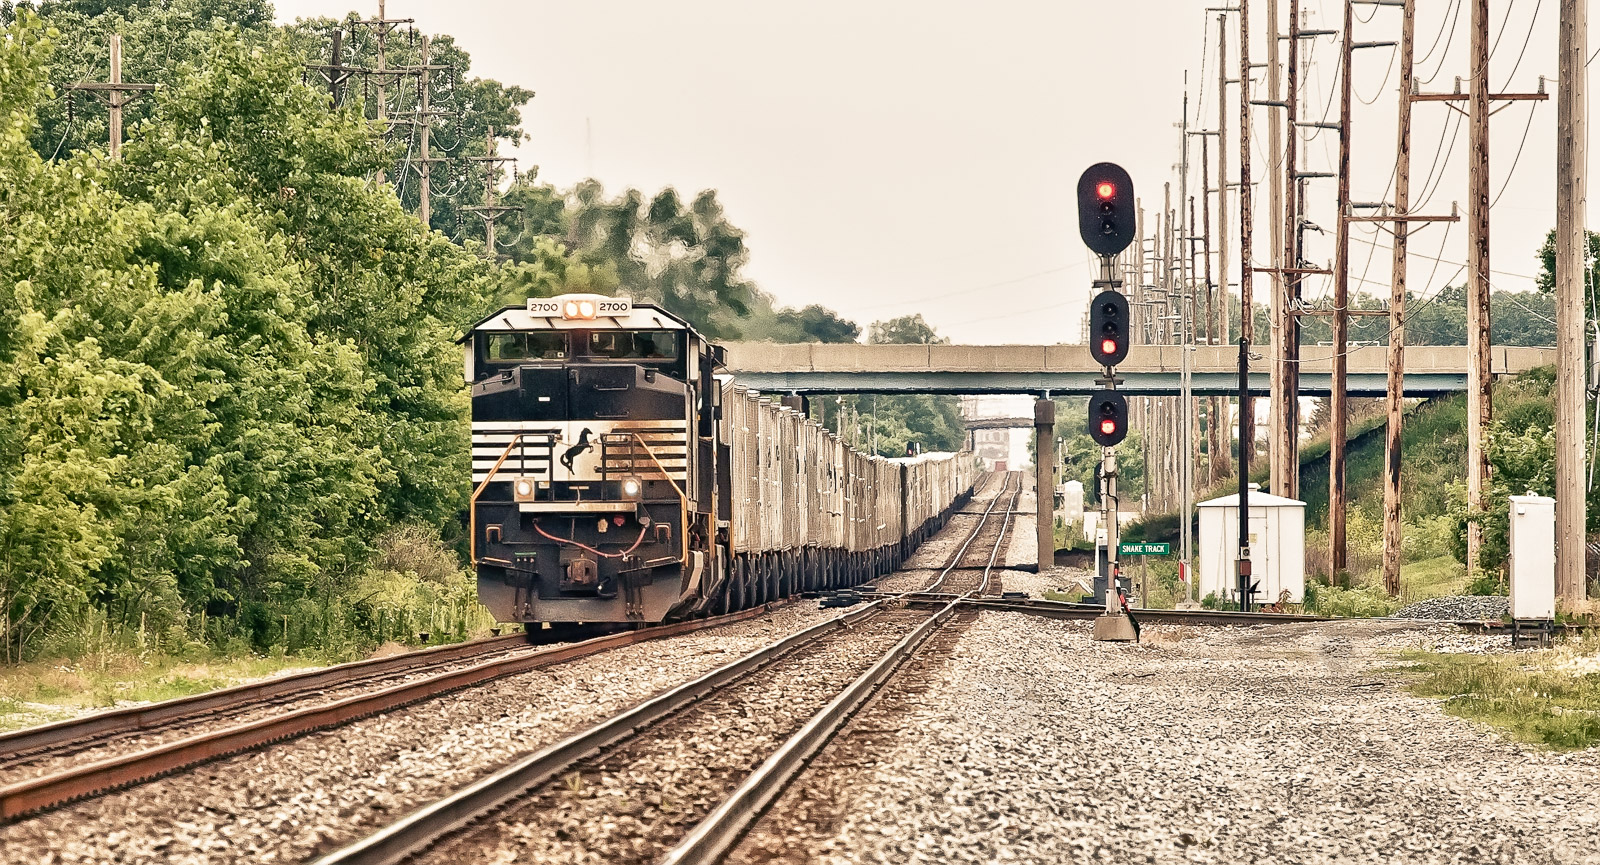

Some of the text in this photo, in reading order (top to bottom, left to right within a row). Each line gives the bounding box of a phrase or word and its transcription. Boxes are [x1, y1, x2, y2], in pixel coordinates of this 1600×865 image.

[530, 303, 559, 312] 2700
[599, 302, 628, 311] 2700
[1122, 544, 1165, 553] SNAKE TRACK
